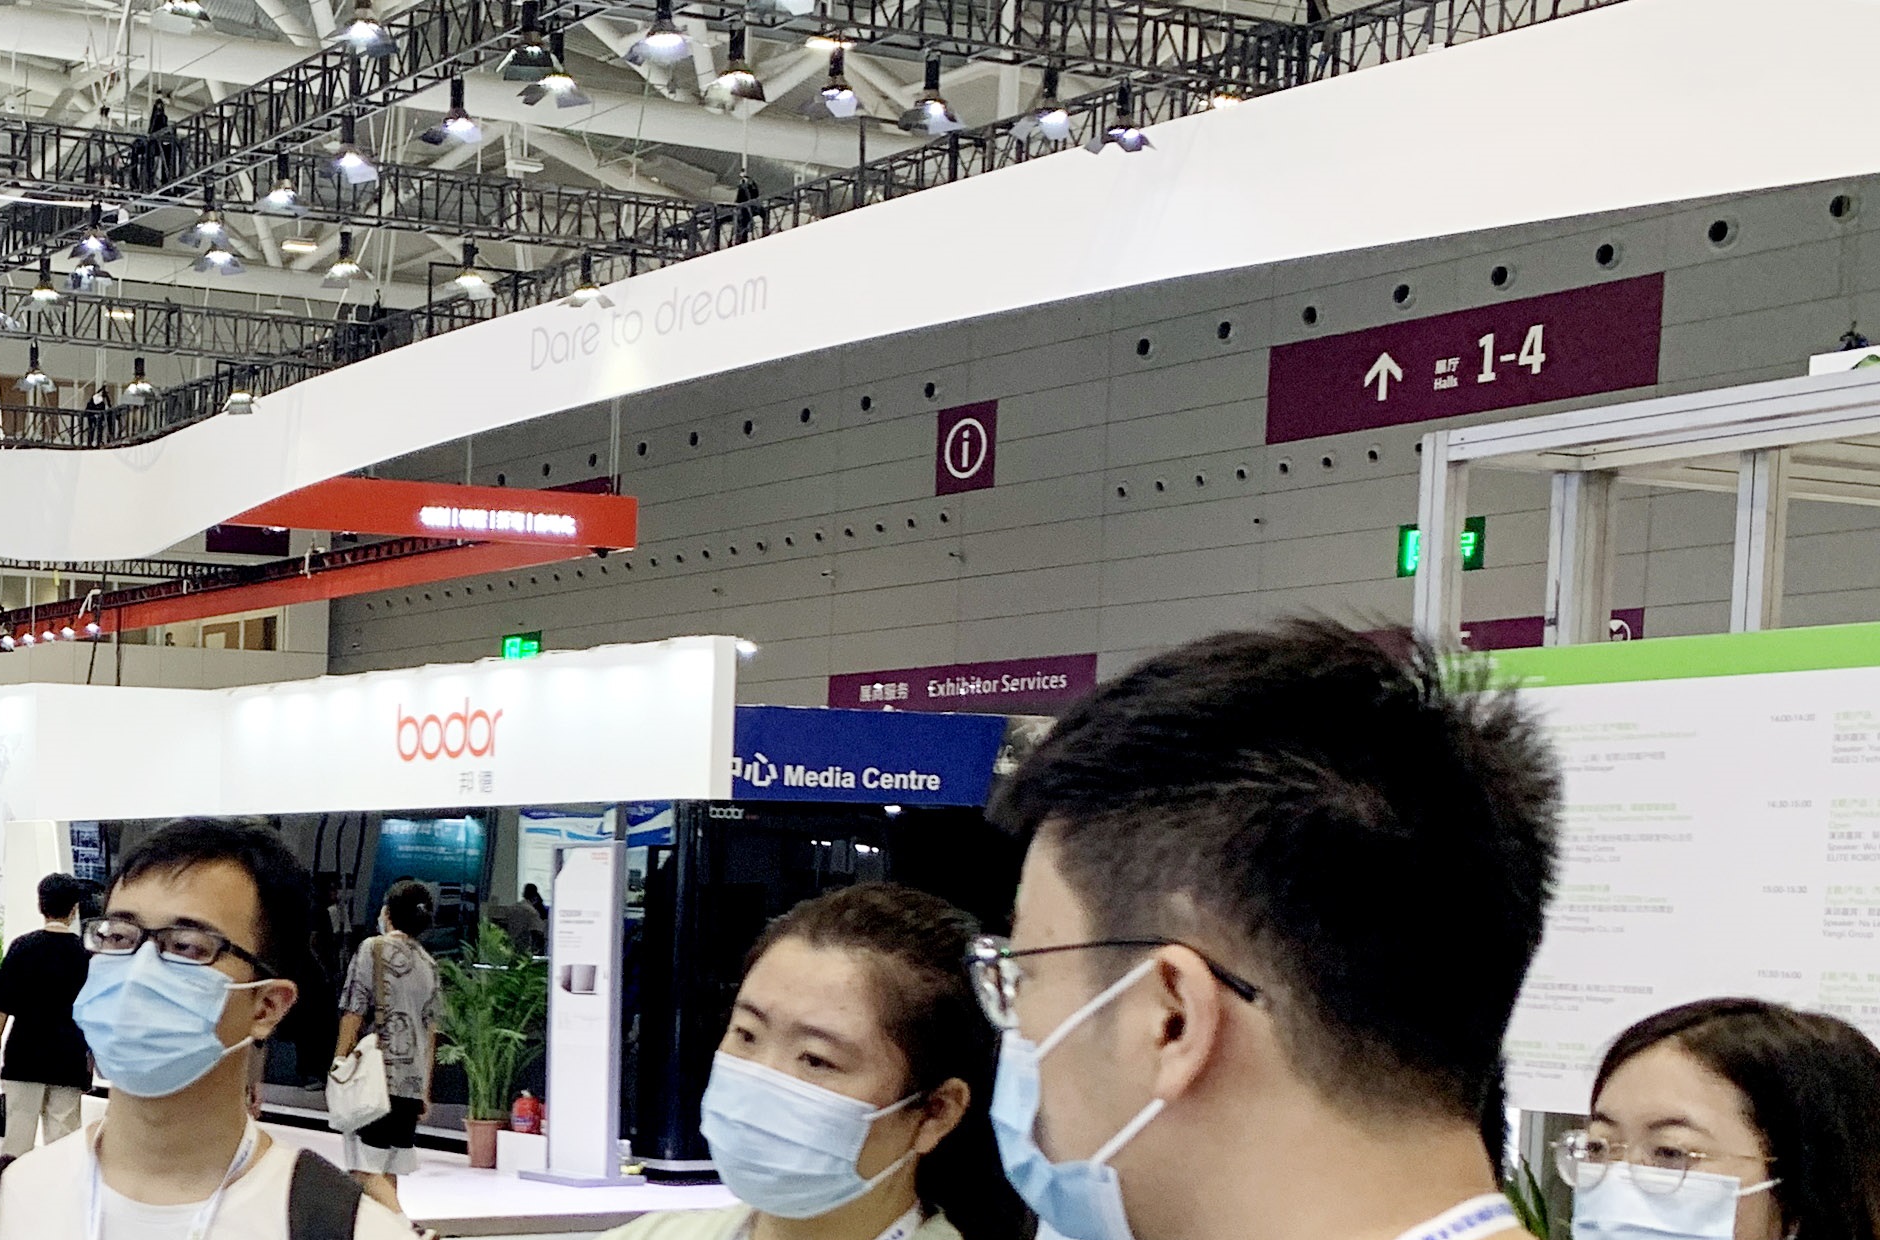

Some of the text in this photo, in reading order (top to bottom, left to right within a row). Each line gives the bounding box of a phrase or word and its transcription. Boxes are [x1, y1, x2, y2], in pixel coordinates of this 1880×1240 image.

[530, 275, 769, 372] Dare to dream
[1477, 324, 1546, 383] 1-4
[1433, 375, 1459, 391] Halls
[927, 675, 999, 698] Exhibitor
[1001, 671, 1068, 693] Services
[397, 697, 503, 762] bodor
[784, 765, 856, 789] Media
[862, 767, 941, 791] Centre
[709, 805, 745, 819] bodor
